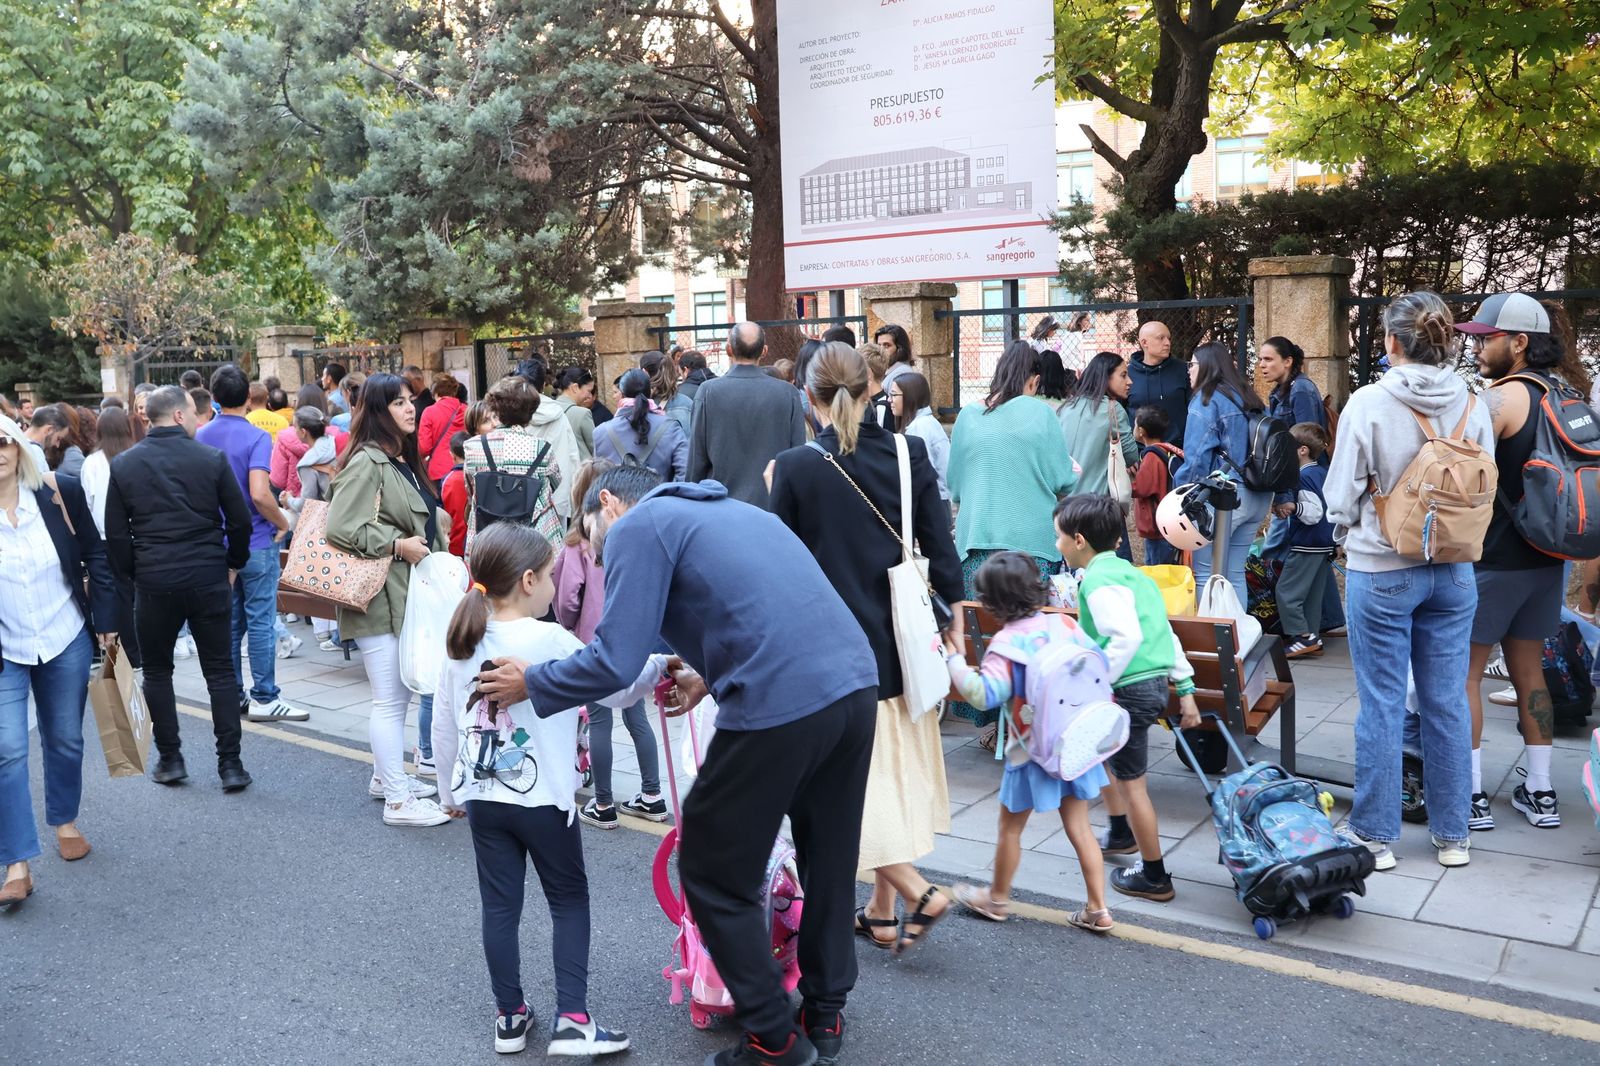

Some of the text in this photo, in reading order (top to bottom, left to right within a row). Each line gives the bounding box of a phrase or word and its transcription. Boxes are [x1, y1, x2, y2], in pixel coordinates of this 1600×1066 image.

[923, 15, 943, 25] ALICIA
[944, 9, 966, 20] RAMOS
[967, 4, 996, 17] FIDALGO
[798, 31, 862, 49] AUTOR DEL PROYECTO:
[939, 38, 960, 49] JAVIER
[960, 32, 990, 45] CAPOTEL
[991, 30, 1004, 39] DEL
[1005, 26, 1025, 36] VALLE
[799, 47, 857, 65] DIRECCIÓN DE OBRA:
[924, 50, 948, 60] VANESA
[949, 44, 979, 56] LORENZO
[976, 51, 996, 61] GAGO
[809, 58, 846, 72] ARQUITECTO:
[809, 68, 845, 81] ARQUITECTO
[809, 76, 850, 90] COORDINADOR
[851, 74, 859, 83] DE
[870, 87, 944, 110] PRESUPUESTO
[873, 106, 942, 128] 805.619,36 €
[799, 262, 830, 272] EMPRESA:
[831, 259, 870, 270] CONTRATAS
[870, 258, 876, 266] Y
[876, 256, 899, 266] OBRAS
[900, 255, 914, 264] SAN
[914, 252, 955, 263] GREGORIO,
[986, 249, 1036, 263] sangregorio
